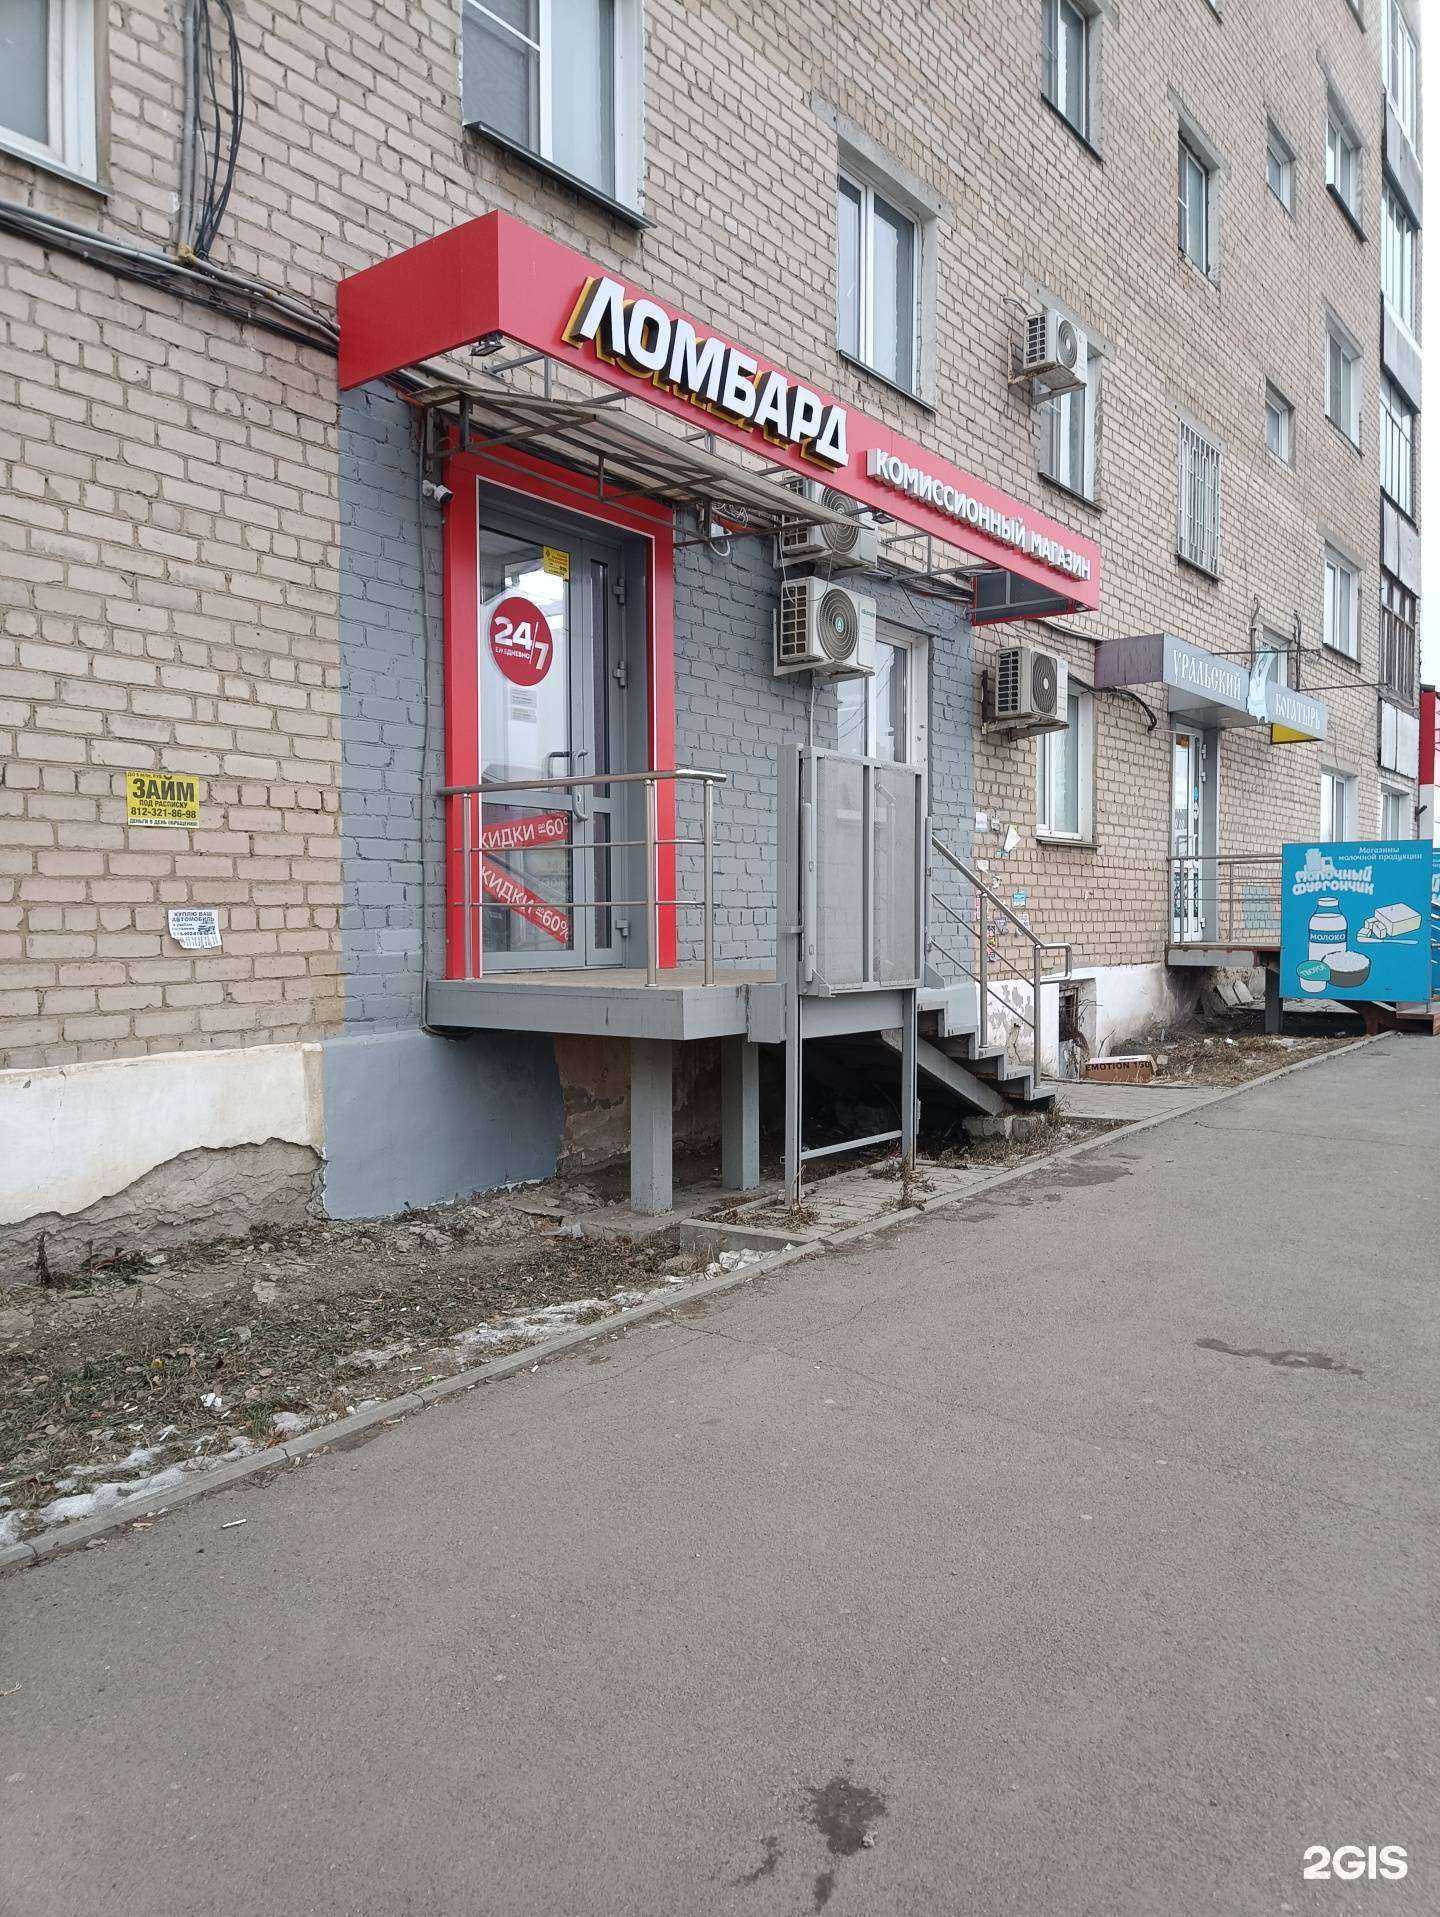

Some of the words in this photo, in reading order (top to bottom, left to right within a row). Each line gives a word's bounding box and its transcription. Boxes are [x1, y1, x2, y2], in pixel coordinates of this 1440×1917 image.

[573, 276, 849, 468] ЛОМБАРД
[867, 448, 1026, 551] КОМИССИОННЫЙ
[1029, 530, 1091, 581] МАГАЗИН
[494, 616, 549, 670] 24/7
[1173, 649, 1241, 701] УРАЛЬСКИЙ
[1275, 692, 1320, 730] БОГАТЫРЬ
[132, 775, 195, 802] ЗАЙМ
[131, 806, 197, 819] 812-321-86-98
[139, 799, 153, 808] ПОД
[154, 800, 188, 809] РАСПИСКУ
[482, 823, 535, 850] КИДКИ
[1379, 854, 1422, 862] продукции
[482, 865, 534, 914] КИДКИ
[1085, 1062, 1129, 1072] EMOTION
